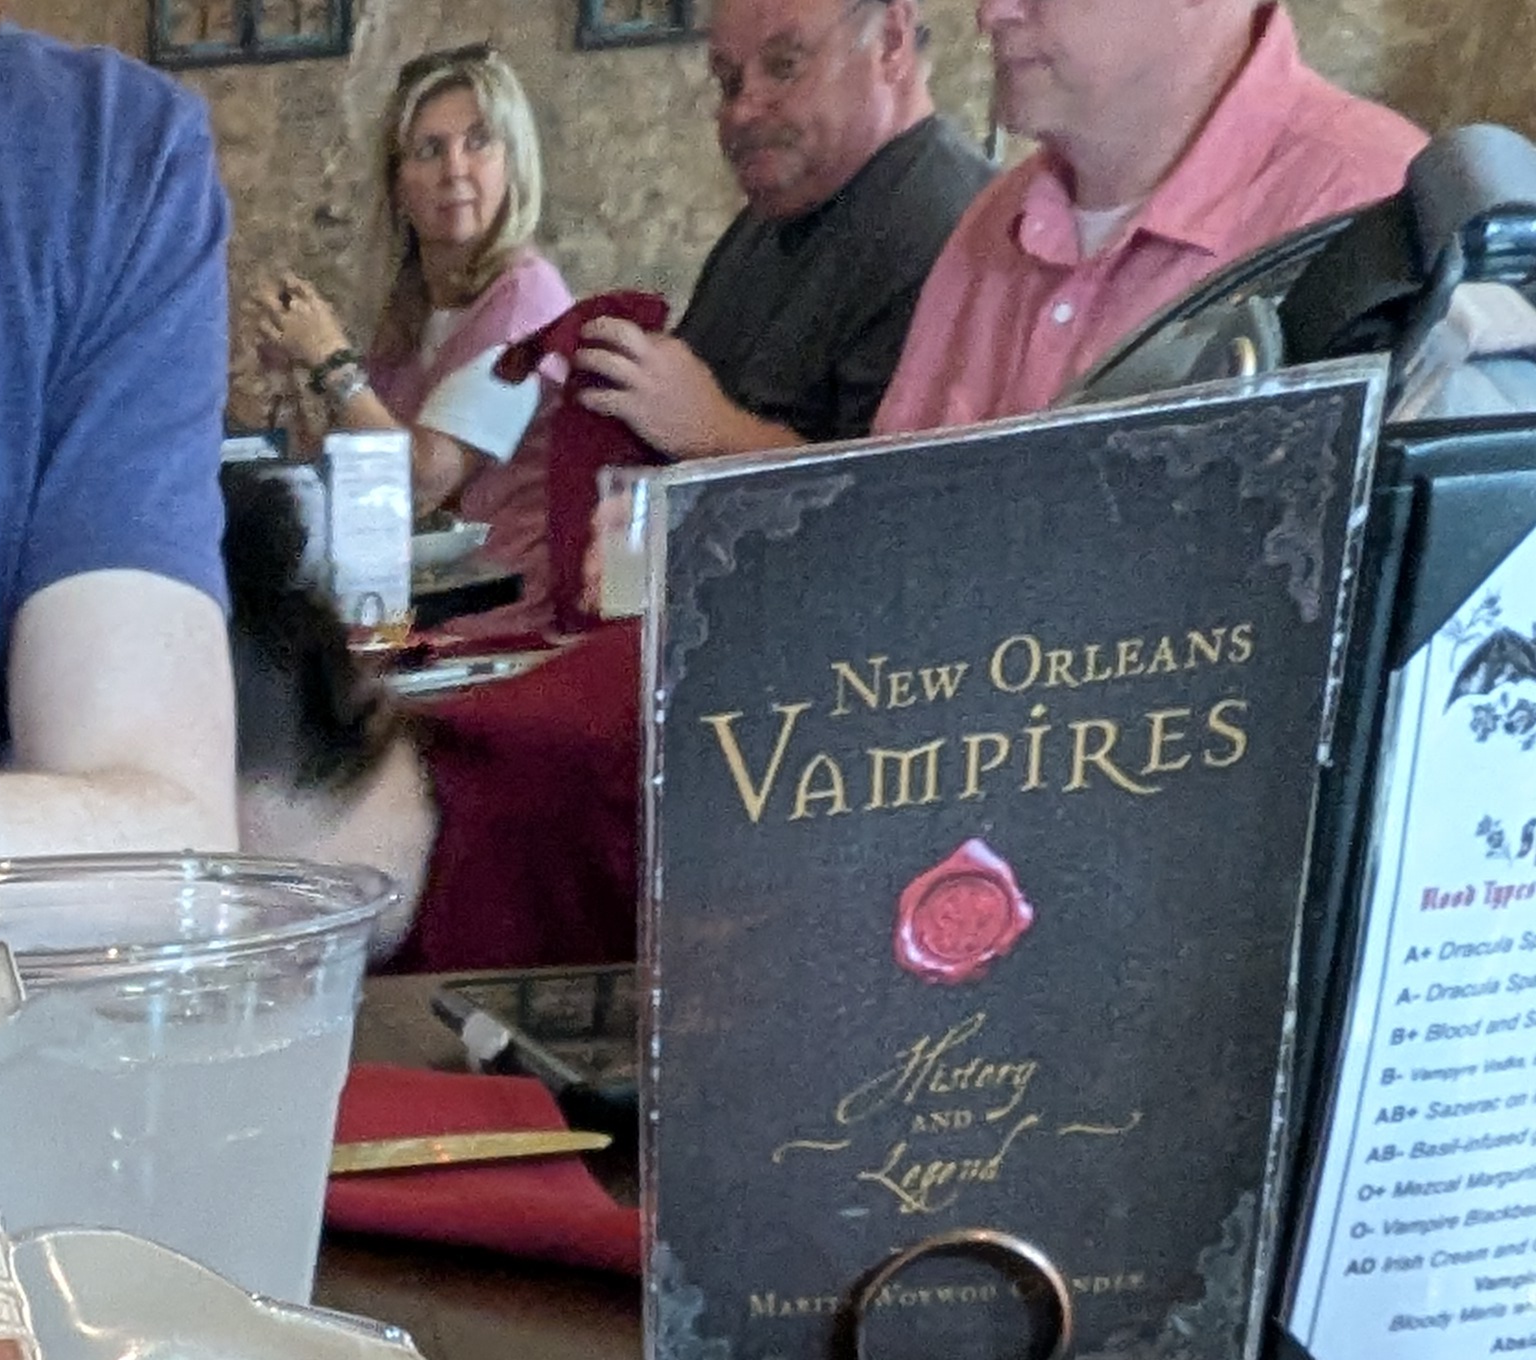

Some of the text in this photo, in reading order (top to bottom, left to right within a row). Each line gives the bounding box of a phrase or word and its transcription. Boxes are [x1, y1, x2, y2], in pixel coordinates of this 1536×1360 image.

[829, 624, 1253, 716] NEW ORLEANS
[699, 700, 1249, 823] VAMPIRES
[913, 1109, 972, 1131] AND
